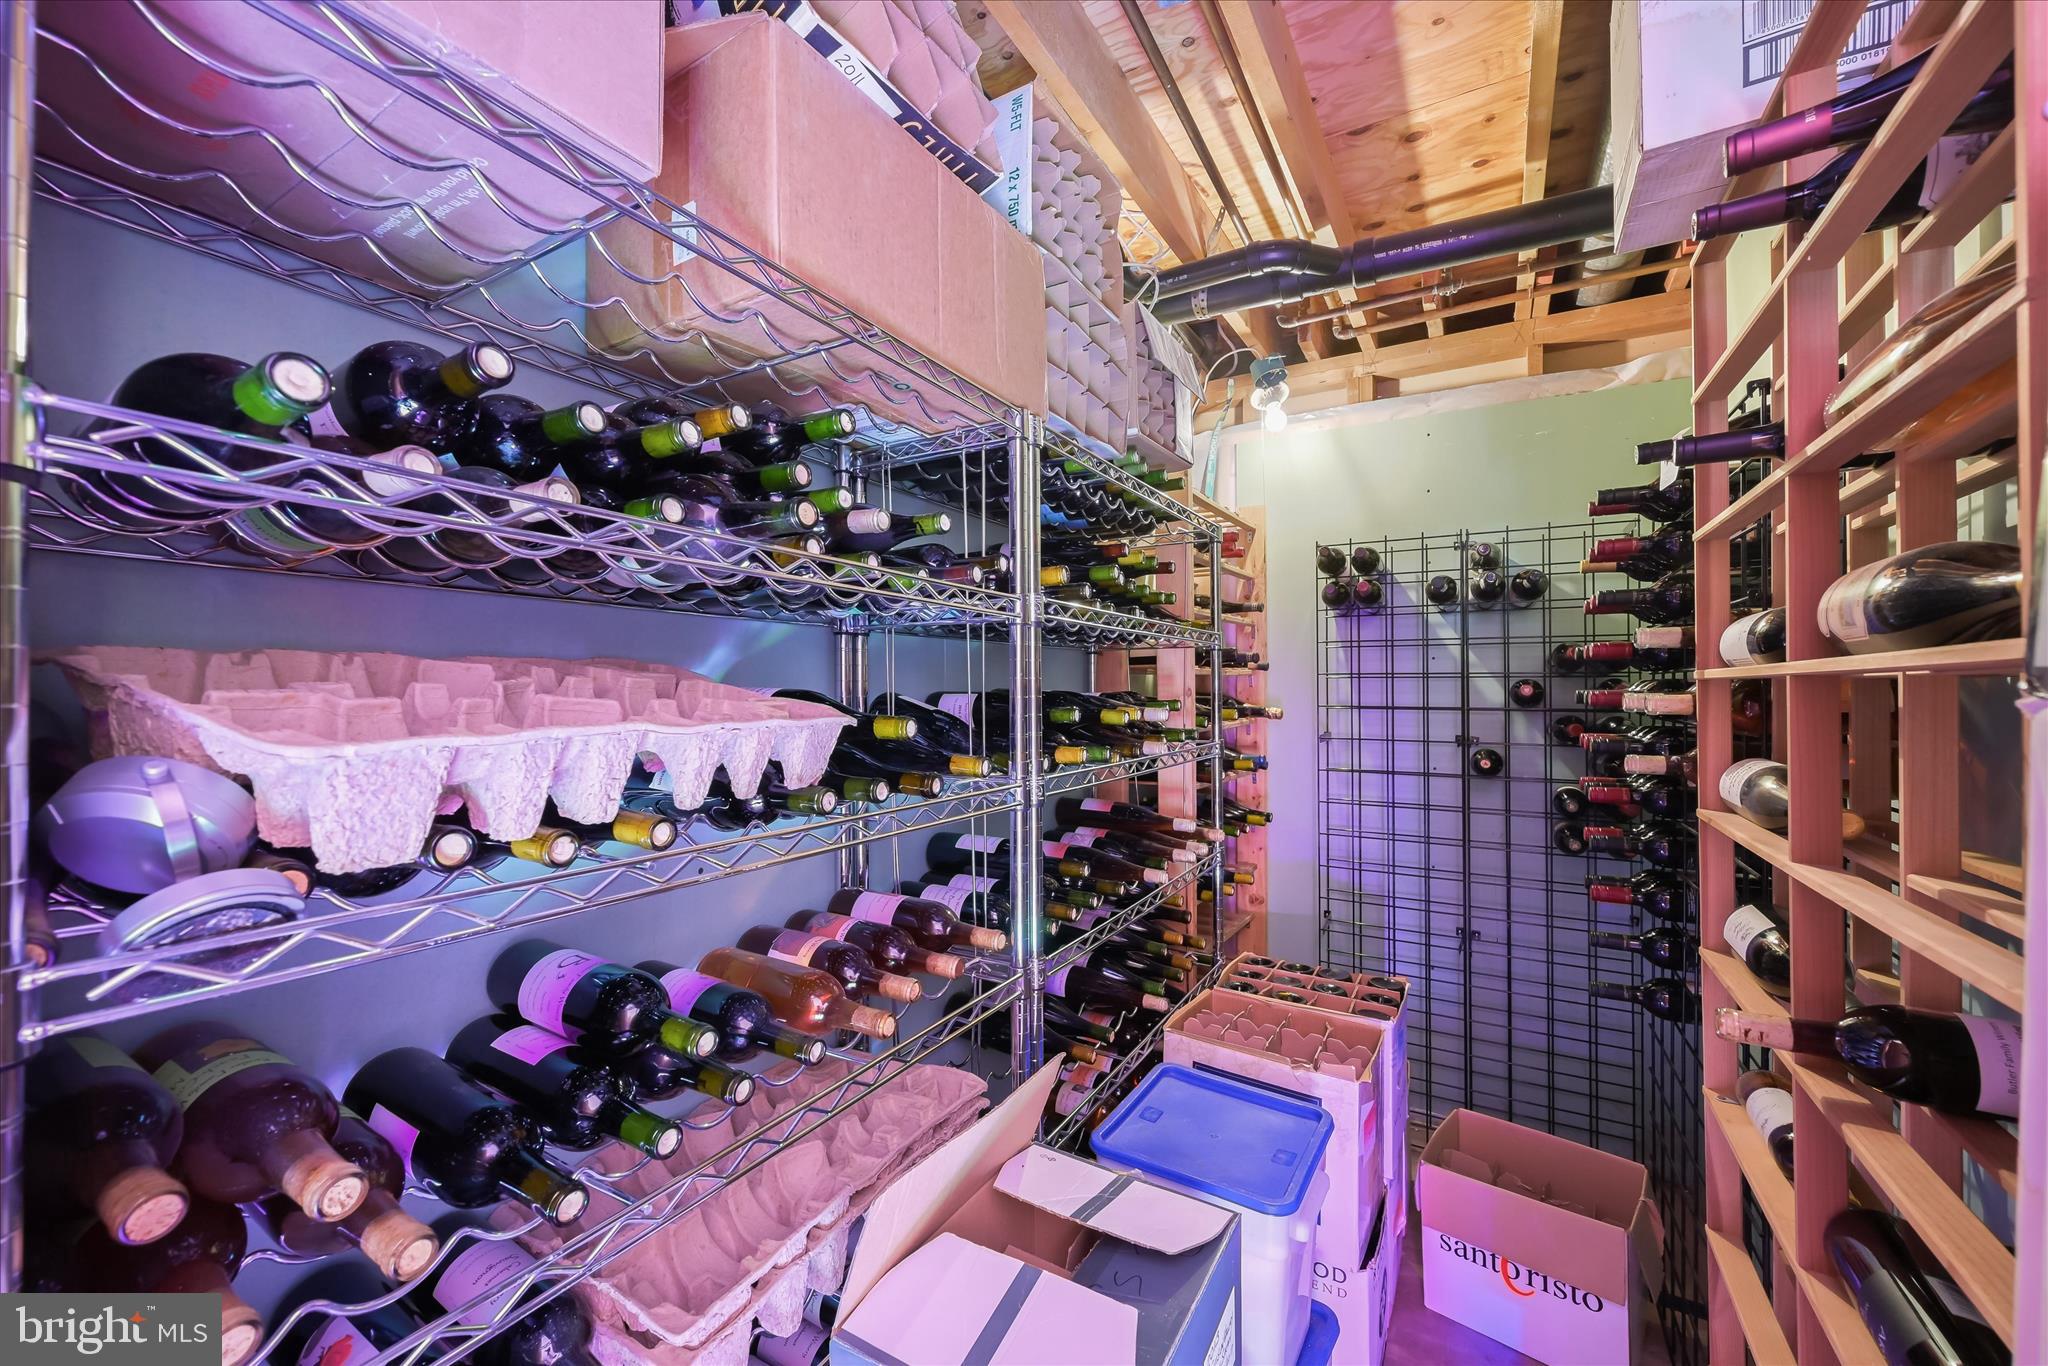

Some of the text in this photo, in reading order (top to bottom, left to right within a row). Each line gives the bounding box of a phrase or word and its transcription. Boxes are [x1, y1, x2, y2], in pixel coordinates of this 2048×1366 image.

[1861, 47, 1890, 61] 0181
[834, 53, 866, 86] 2011
[1010, 94, 1024, 132] W5-FLT
[1008, 166, 1020, 183] 12
[1008, 194, 1020, 218] 750
